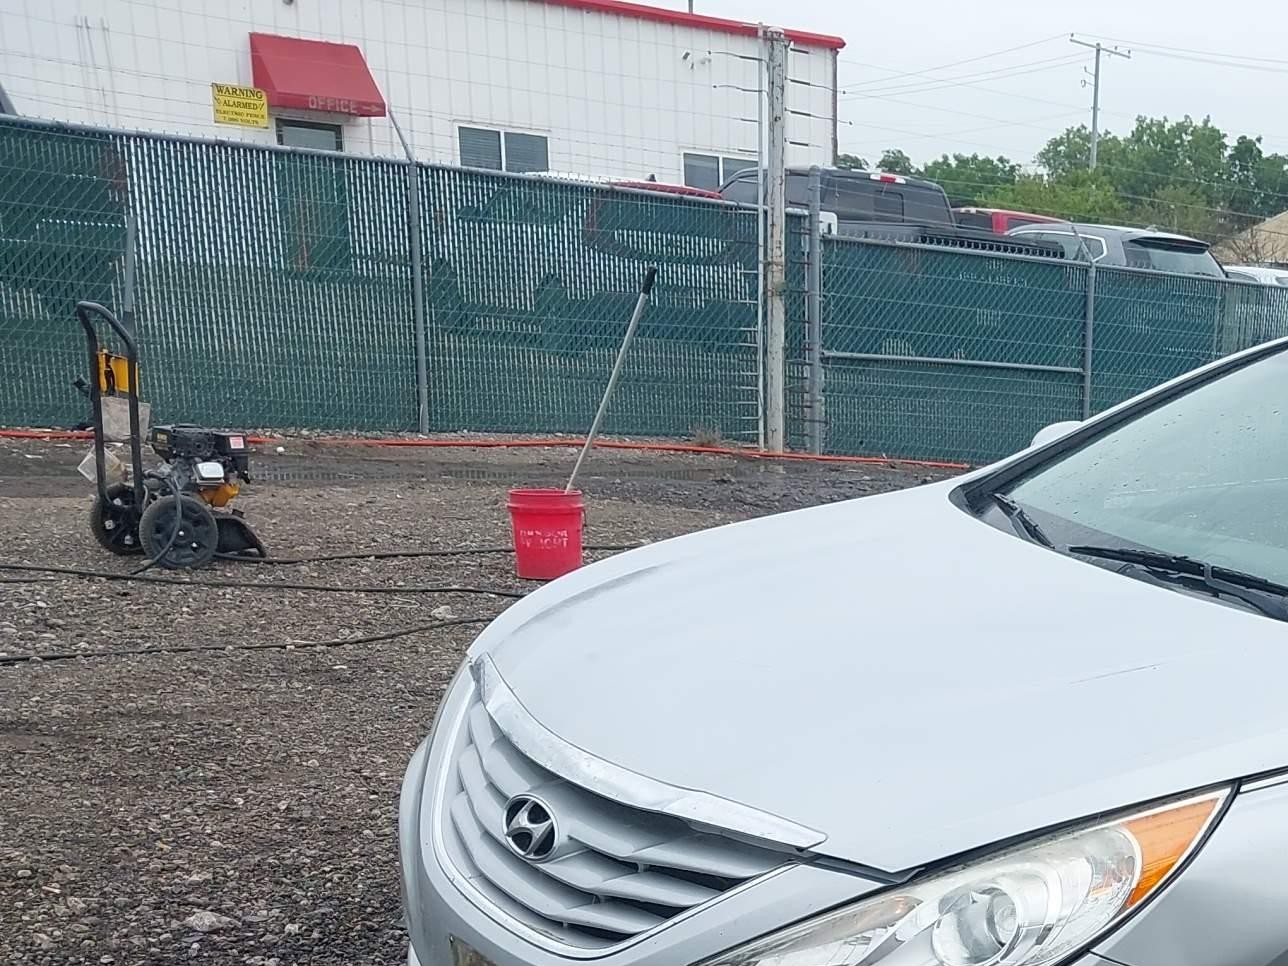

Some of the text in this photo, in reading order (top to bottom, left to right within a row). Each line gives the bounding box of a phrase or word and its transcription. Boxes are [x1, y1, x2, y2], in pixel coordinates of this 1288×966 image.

[215, 85, 263, 99] WARNING
[223, 100, 258, 111] ALARMED
[309, 95, 357, 114] OFFICE
